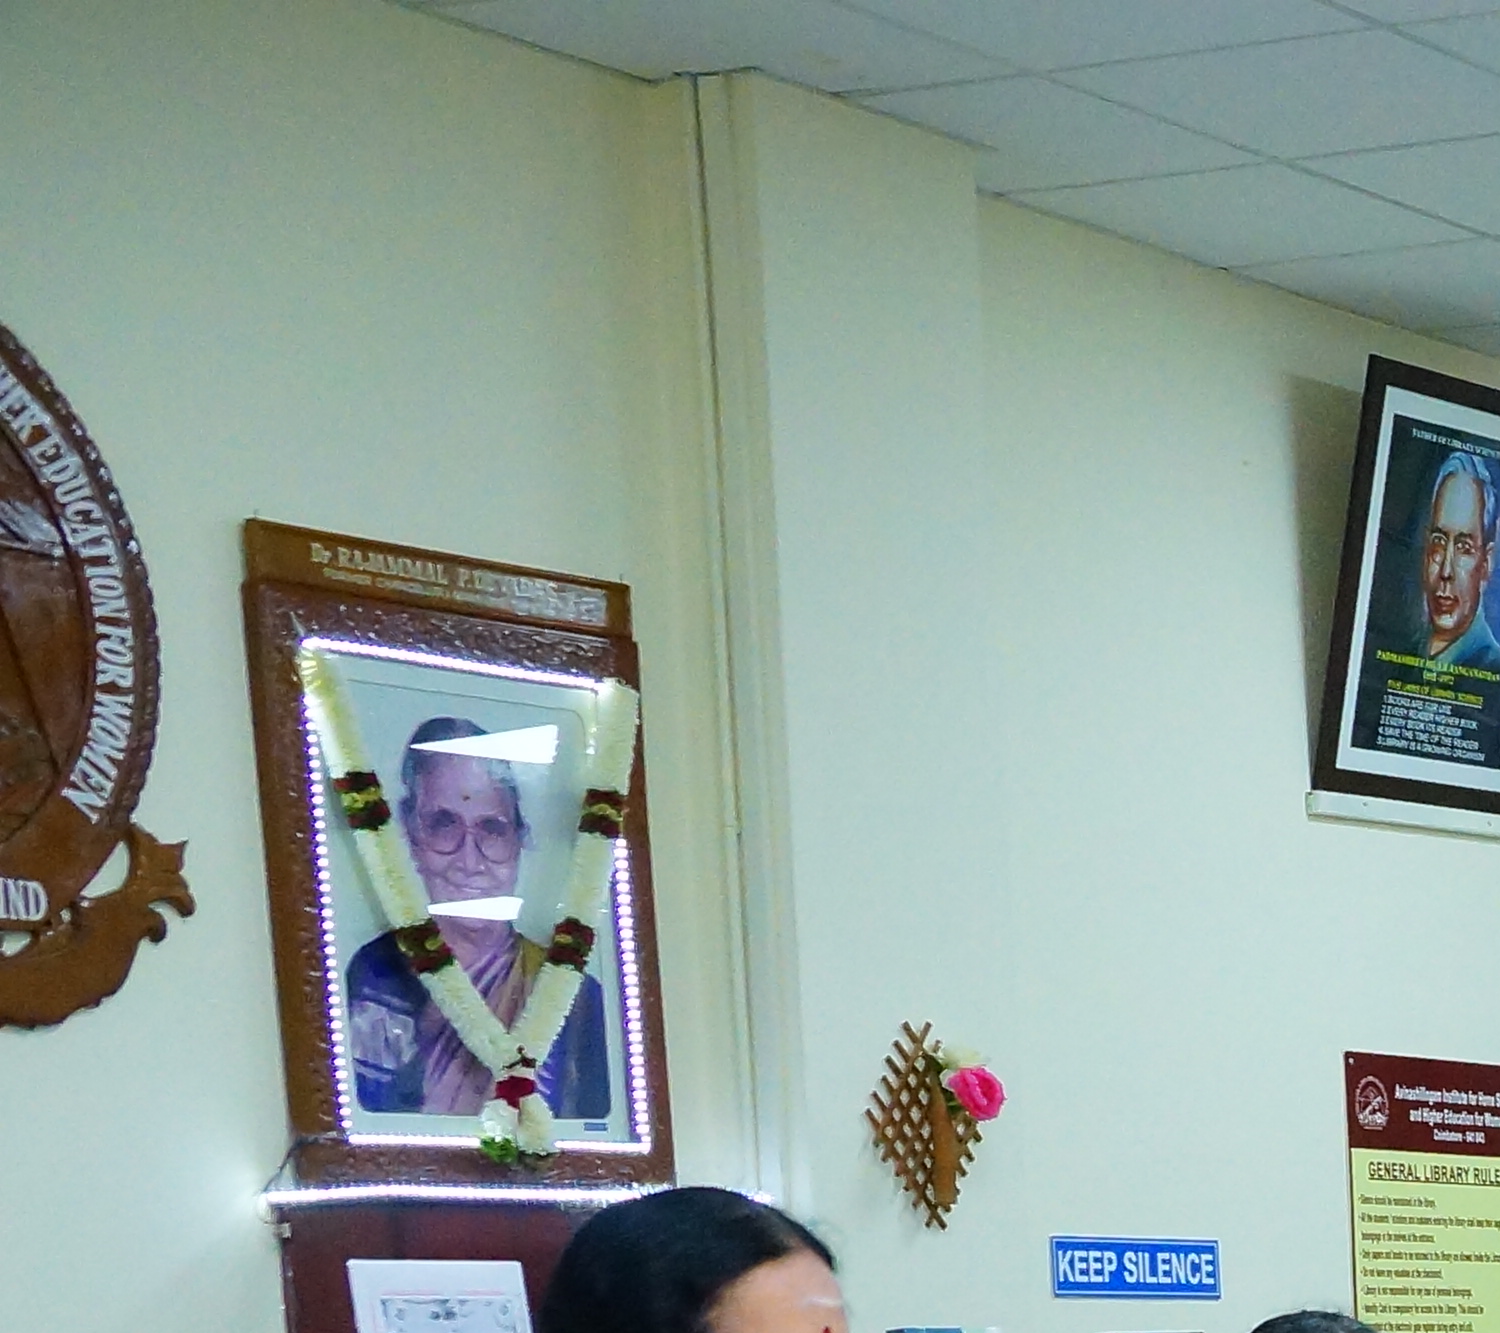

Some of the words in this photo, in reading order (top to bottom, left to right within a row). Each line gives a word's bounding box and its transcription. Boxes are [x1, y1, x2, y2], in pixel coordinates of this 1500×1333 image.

[27, 434, 131, 621] EDUCATION
[94, 621, 134, 689] FOR
[61, 690, 134, 825] WOMEN
[1368, 1161, 1423, 1180] GENERAL
[1424, 1165, 1471, 1183] LIBRARY
[1057, 1250, 1117, 1283] KEEP
[1123, 1251, 1215, 1284] SILENCE
